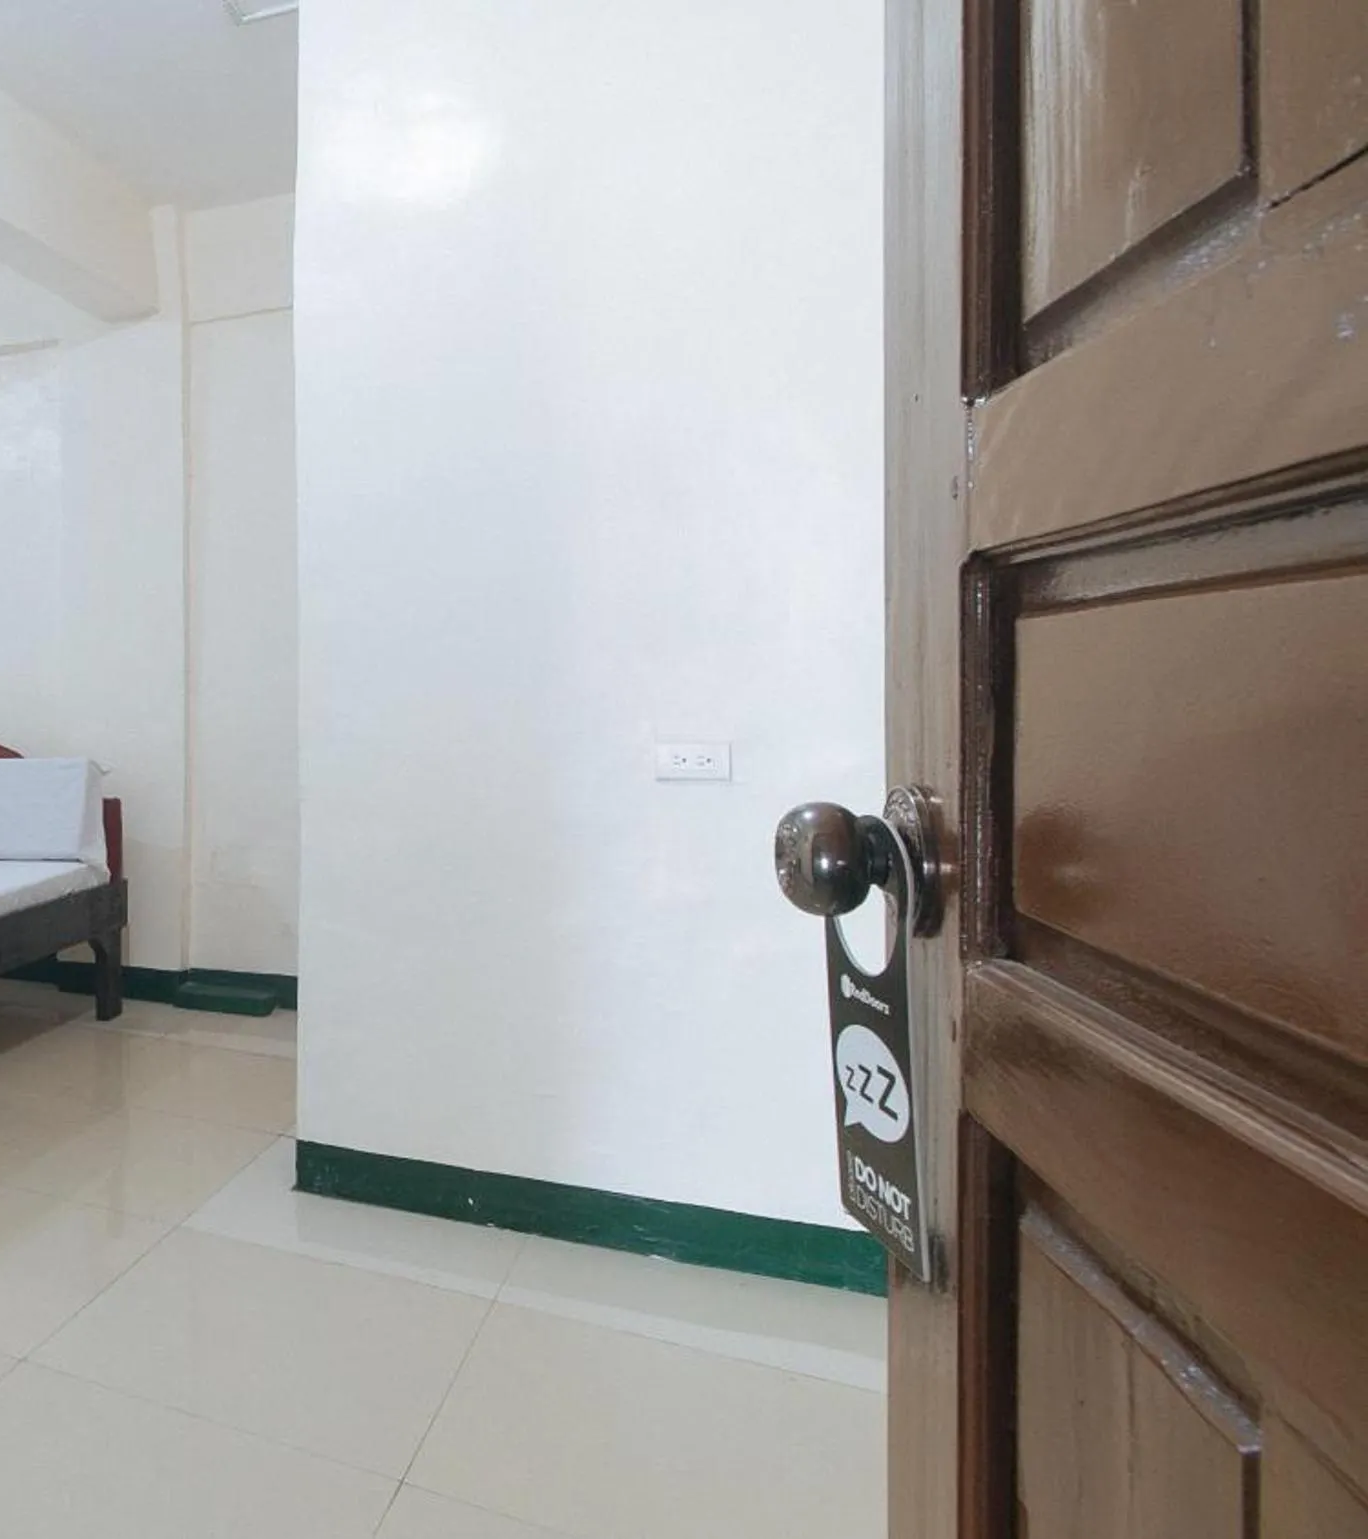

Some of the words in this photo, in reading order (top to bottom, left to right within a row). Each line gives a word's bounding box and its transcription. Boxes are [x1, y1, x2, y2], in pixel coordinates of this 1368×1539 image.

[854, 1156, 877, 1192] DO
[878, 1173, 911, 1221] NOT
[856, 1184, 915, 1253] DISTURB
